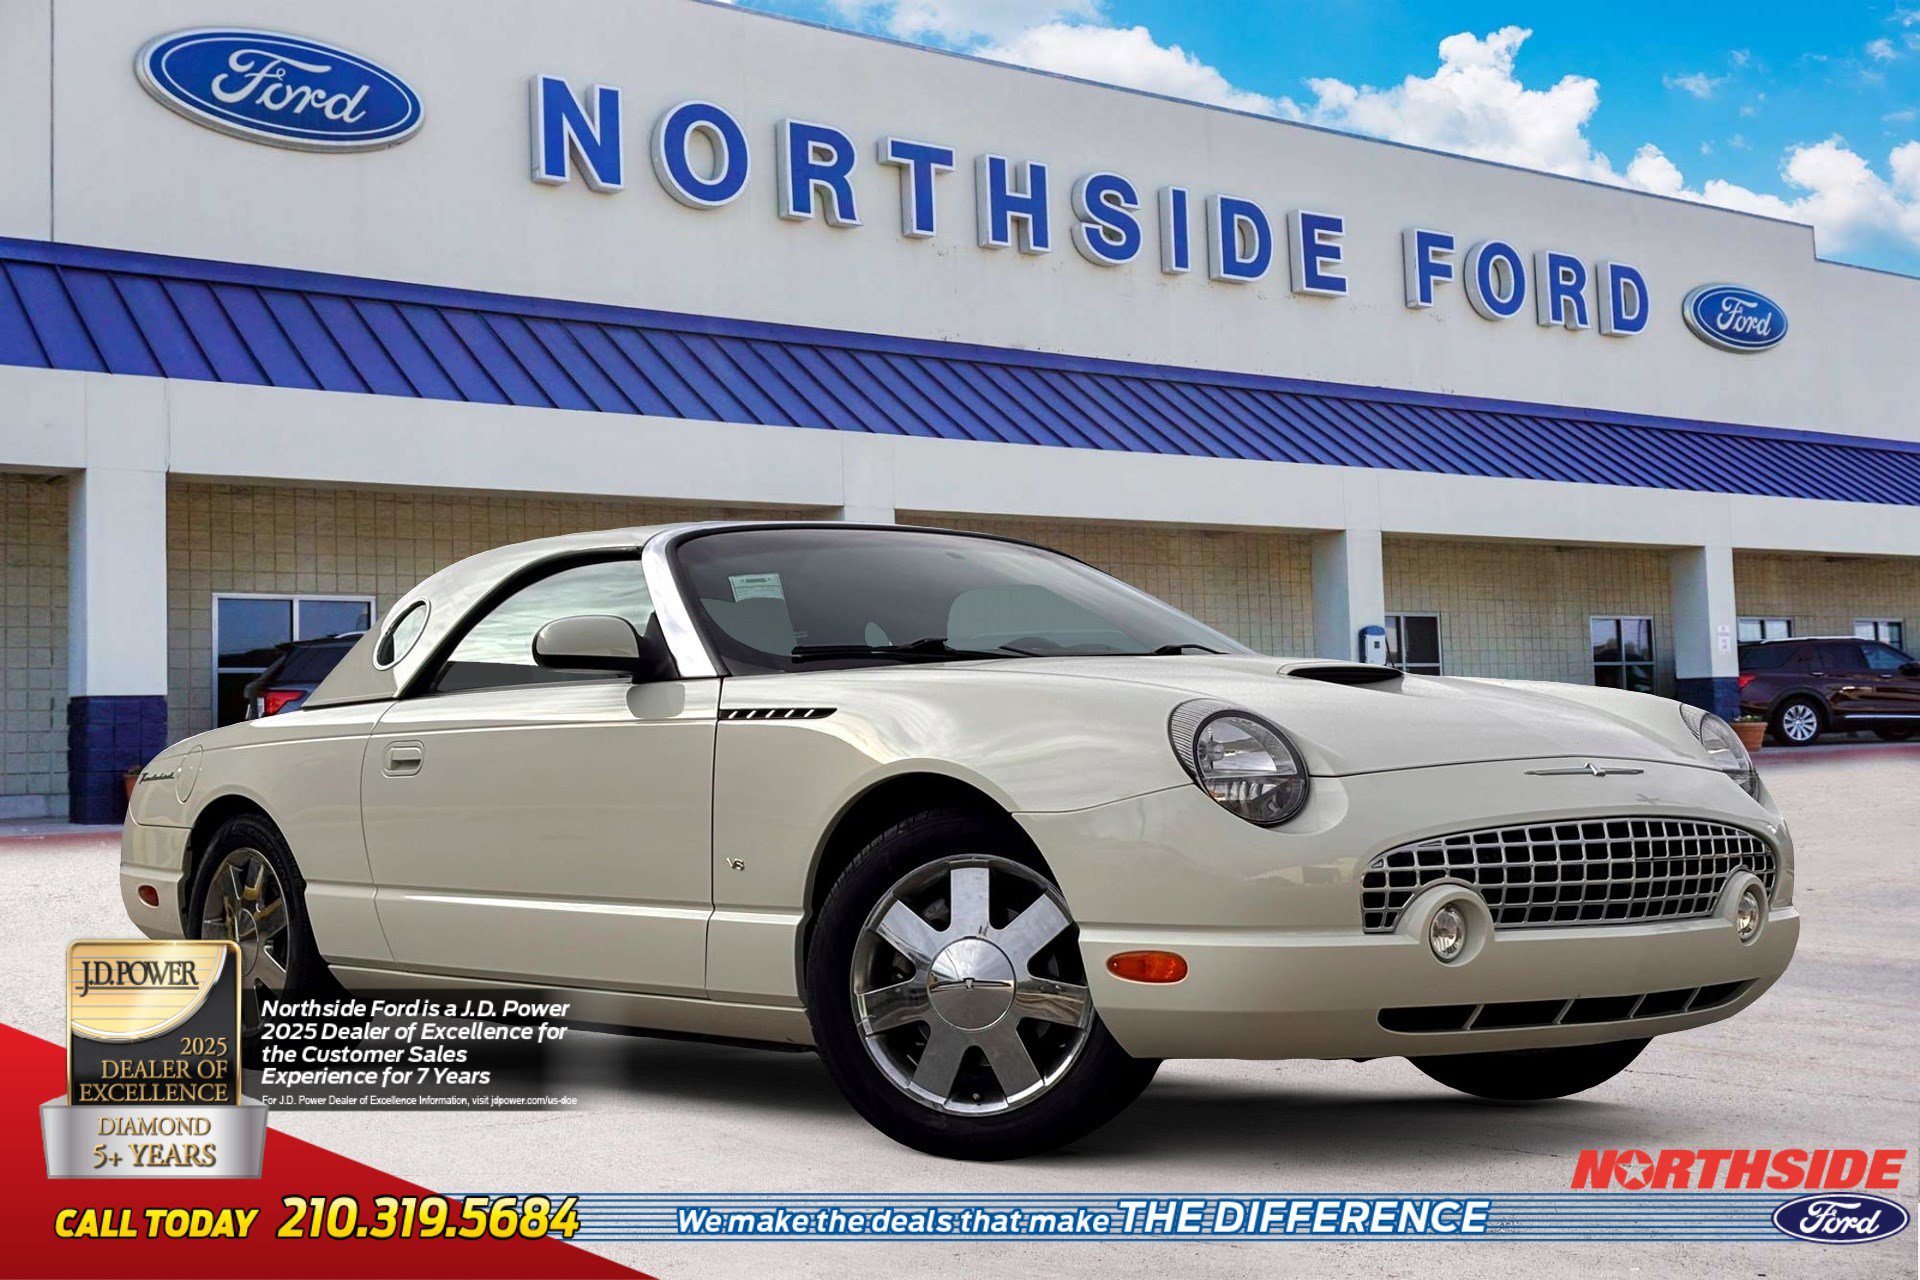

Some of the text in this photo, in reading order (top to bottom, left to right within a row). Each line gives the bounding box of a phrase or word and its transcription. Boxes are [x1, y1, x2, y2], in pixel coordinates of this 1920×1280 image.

[210, 48, 368, 124] Ford
[530, 73, 1650, 338] NORTHSIDE FORD
[1716, 297, 1773, 337] Ford
